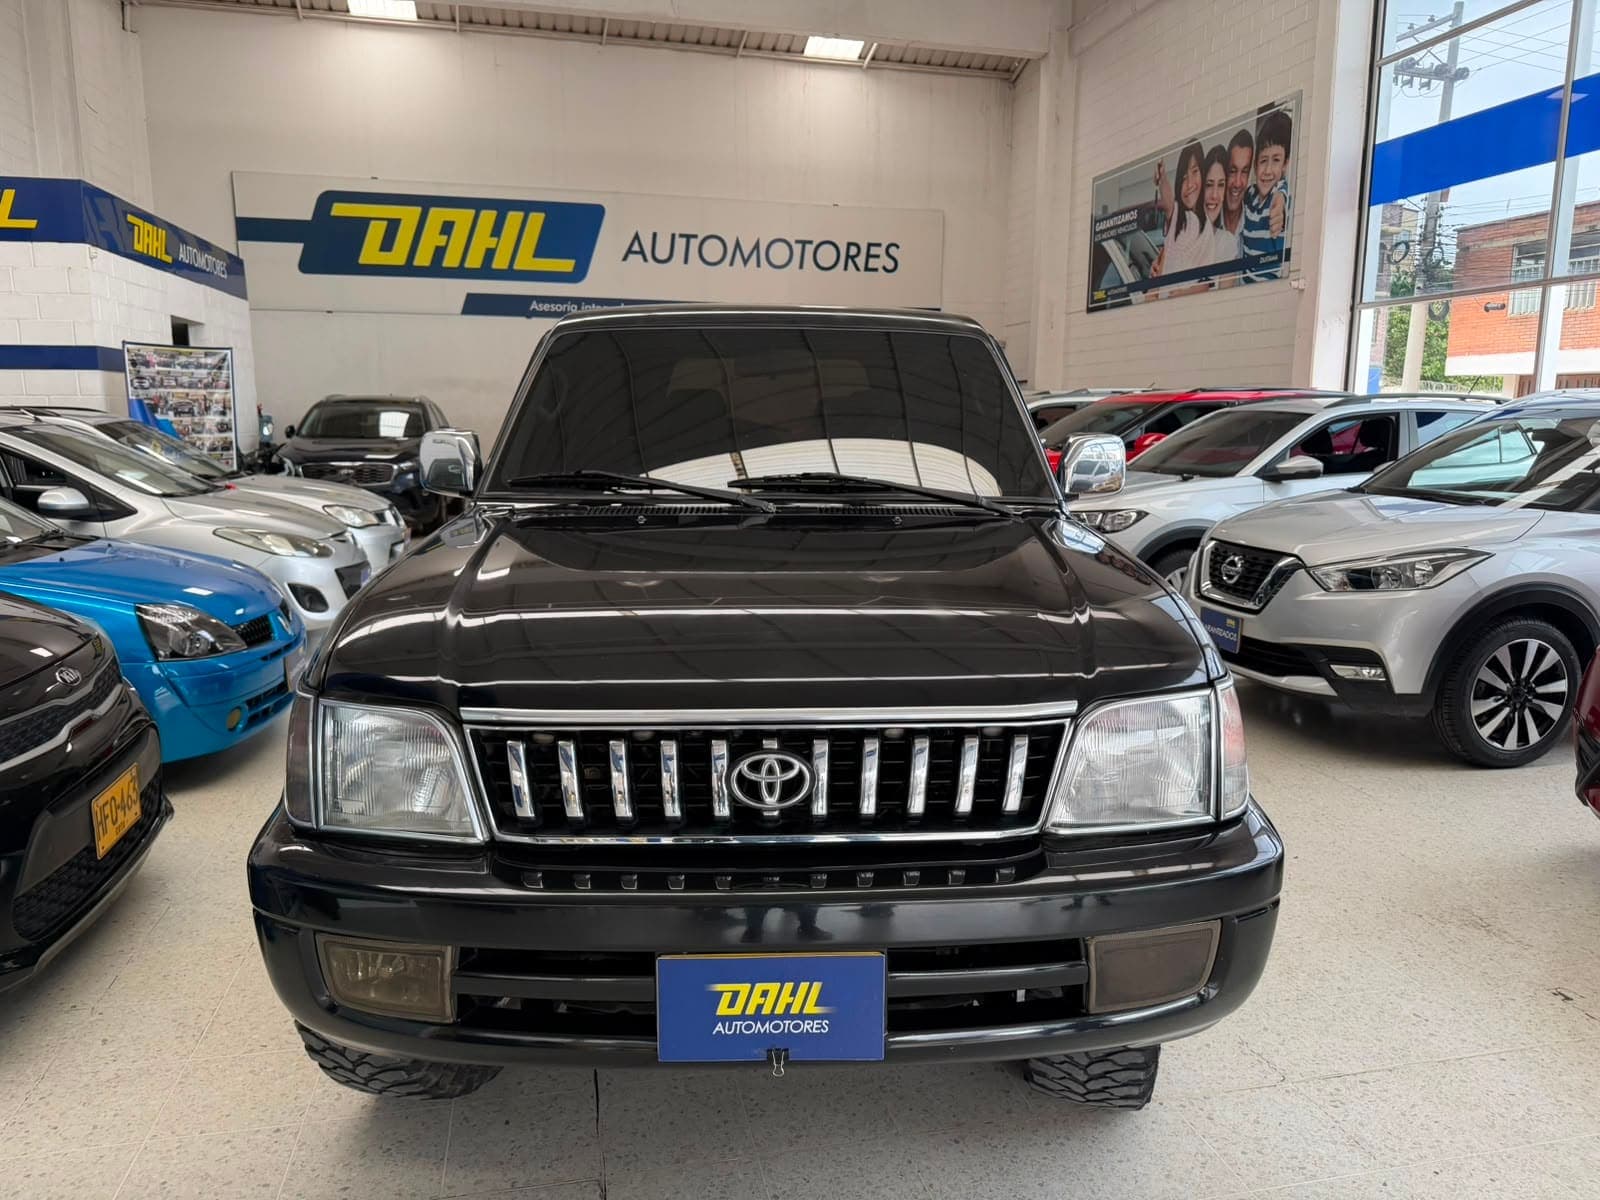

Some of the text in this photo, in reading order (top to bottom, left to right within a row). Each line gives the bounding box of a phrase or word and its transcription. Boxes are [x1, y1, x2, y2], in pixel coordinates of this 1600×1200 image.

[127, 214, 227, 279] DAHL AUTOMOTORES
[330, 203, 900, 274] DAHL AUTOMOTORES
[706, 982, 836, 1016] DAHL
[712, 1019, 830, 1035] AUTOMOTORES
